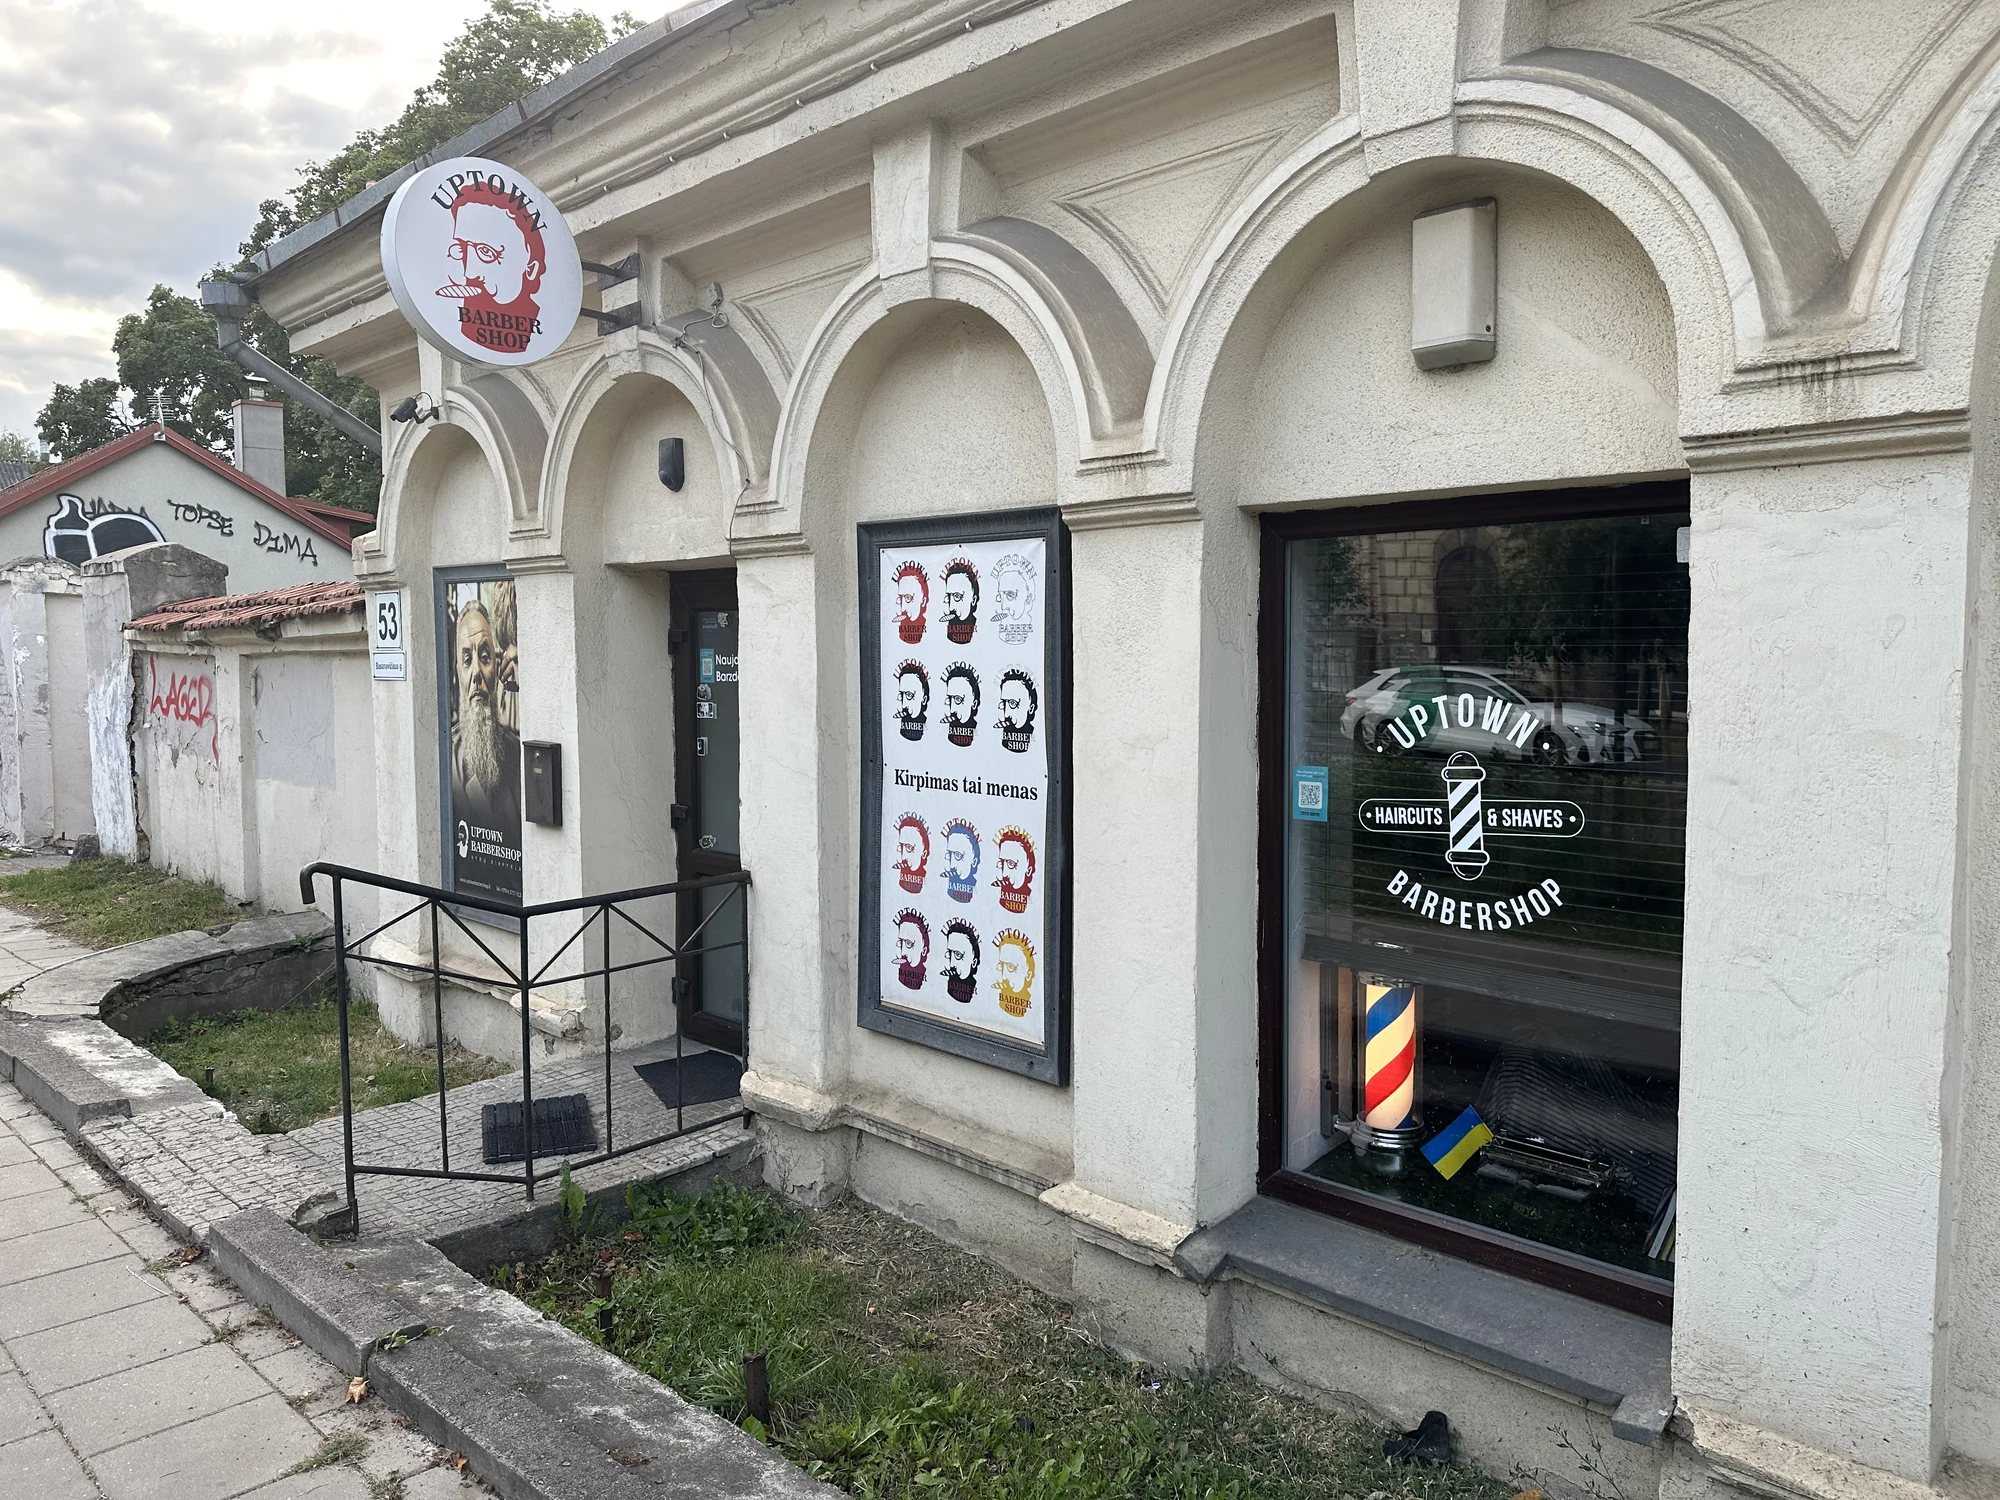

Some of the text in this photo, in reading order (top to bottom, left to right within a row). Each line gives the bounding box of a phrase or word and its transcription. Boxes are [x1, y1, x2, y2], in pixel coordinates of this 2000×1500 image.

[431, 170, 548, 233] UPTOWN
[457, 306, 543, 335] BARBER
[476, 327, 531, 349] SHOP
[891, 560, 930, 583] UPTOWN
[939, 557, 981, 582] UPTOWN
[990, 553, 1037, 579] UPTOWN
[379, 602, 398, 640] 53
[899, 625, 927, 633] BARBER
[947, 625, 978, 633] BARBER
[999, 623, 1033, 633] BARBER
[904, 633, 922, 641] SHOP
[953, 633, 973, 641] SHOP
[716, 671, 739, 682] Barzd
[893, 658, 931, 682] UPTOWN
[940, 661, 982, 685] UPTOWN
[1387, 693, 1539, 749] UPTOWN
[894, 768, 1038, 801] Kirpimas tai menas
[893, 811, 931, 836] UPTOWN
[1375, 807, 1563, 828] HAIRCUTS & SHAVES
[471, 825, 502, 843] UPTOWN
[940, 817, 982, 845] UPTOWN
[992, 824, 1037, 852] UPTOWN
[471, 840, 522, 861] BARBERSHOP
[1386, 869, 1564, 931] BARBERSHOP
[892, 907, 932, 934] UPTOWN
[941, 917, 982, 944] UPTOWN
[992, 927, 1037, 957] UPTOWN
[999, 993, 1032, 1009] BARBER
[1005, 1004, 1027, 1016] SHOP
